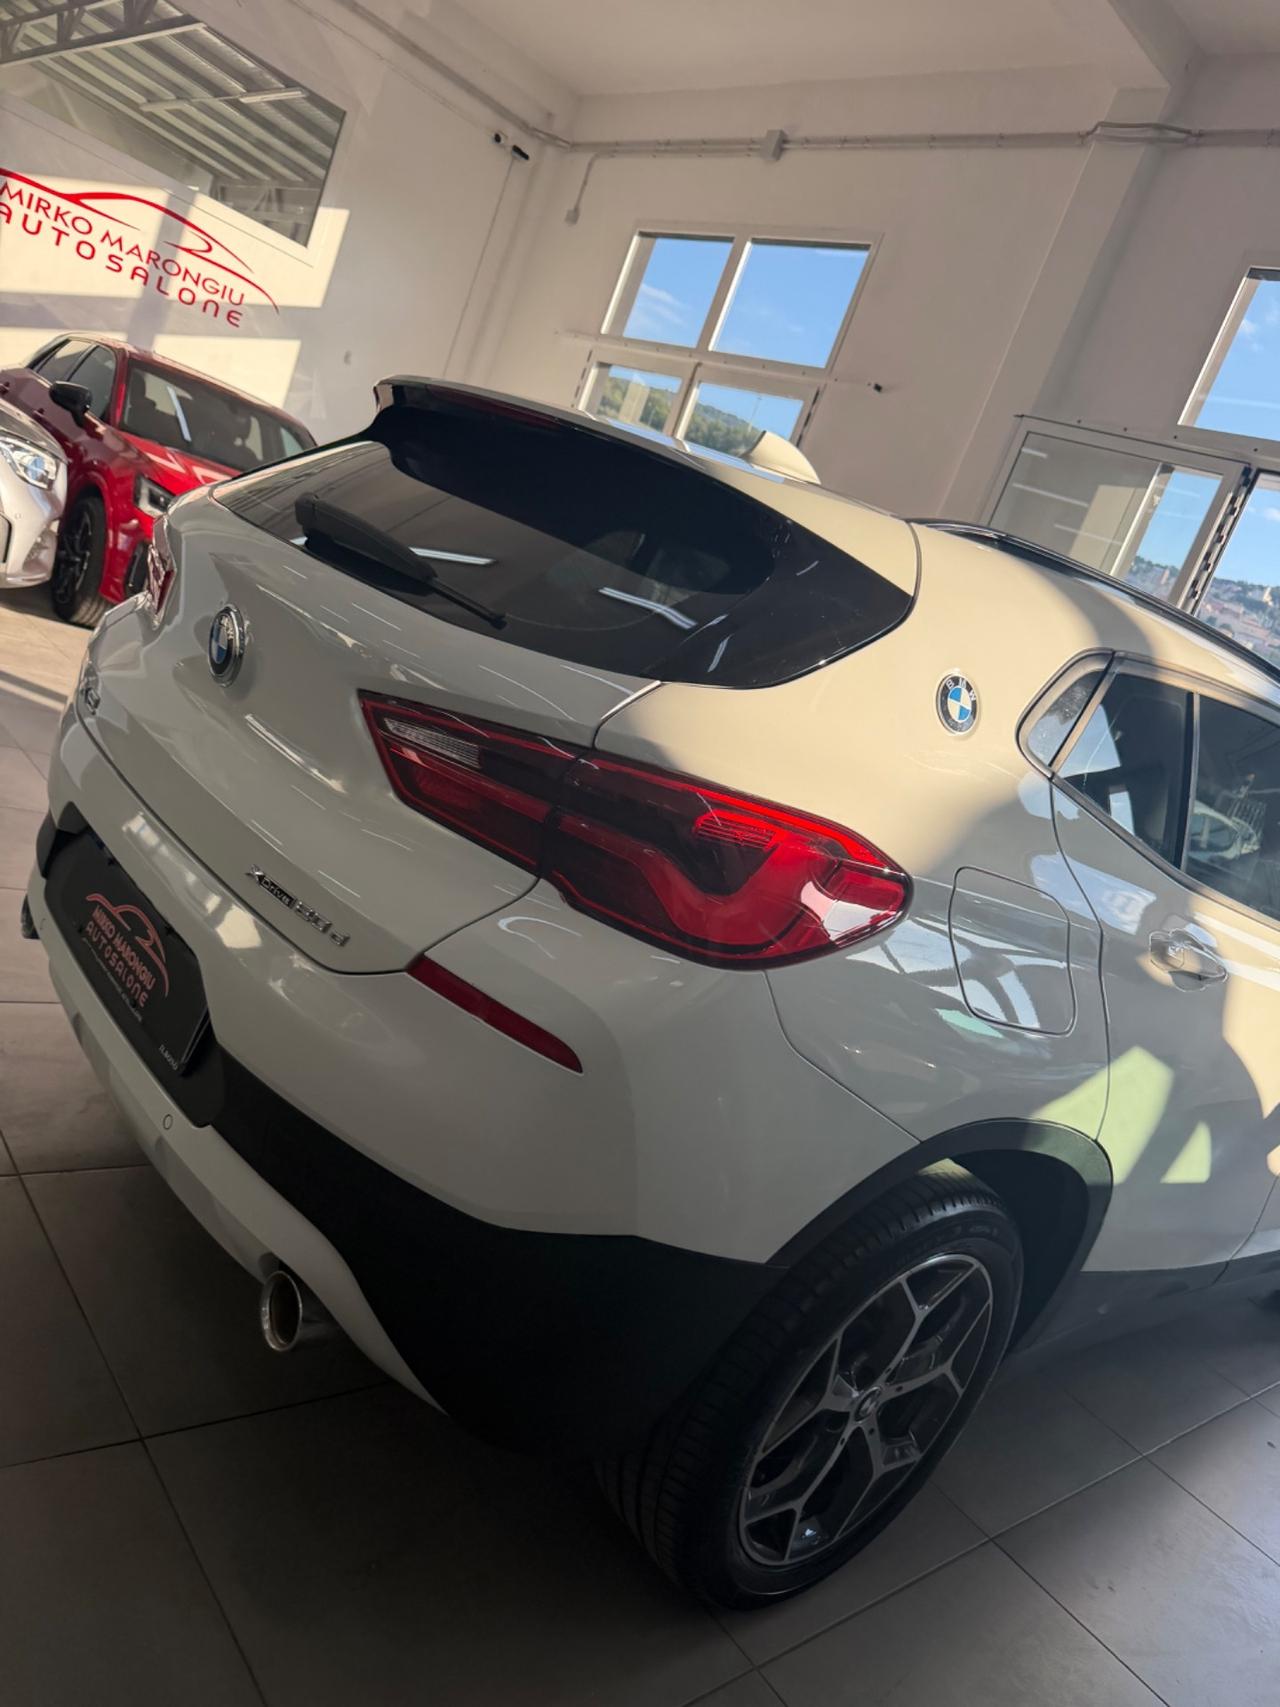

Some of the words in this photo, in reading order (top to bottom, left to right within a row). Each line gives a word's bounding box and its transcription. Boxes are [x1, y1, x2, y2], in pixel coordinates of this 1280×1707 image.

[0, 180, 93, 236] MIRKO
[100, 229, 245, 306] MARONGIU
[945, 676, 977, 702] BMW
[85, 920, 149, 1008] AUTOSALONE
